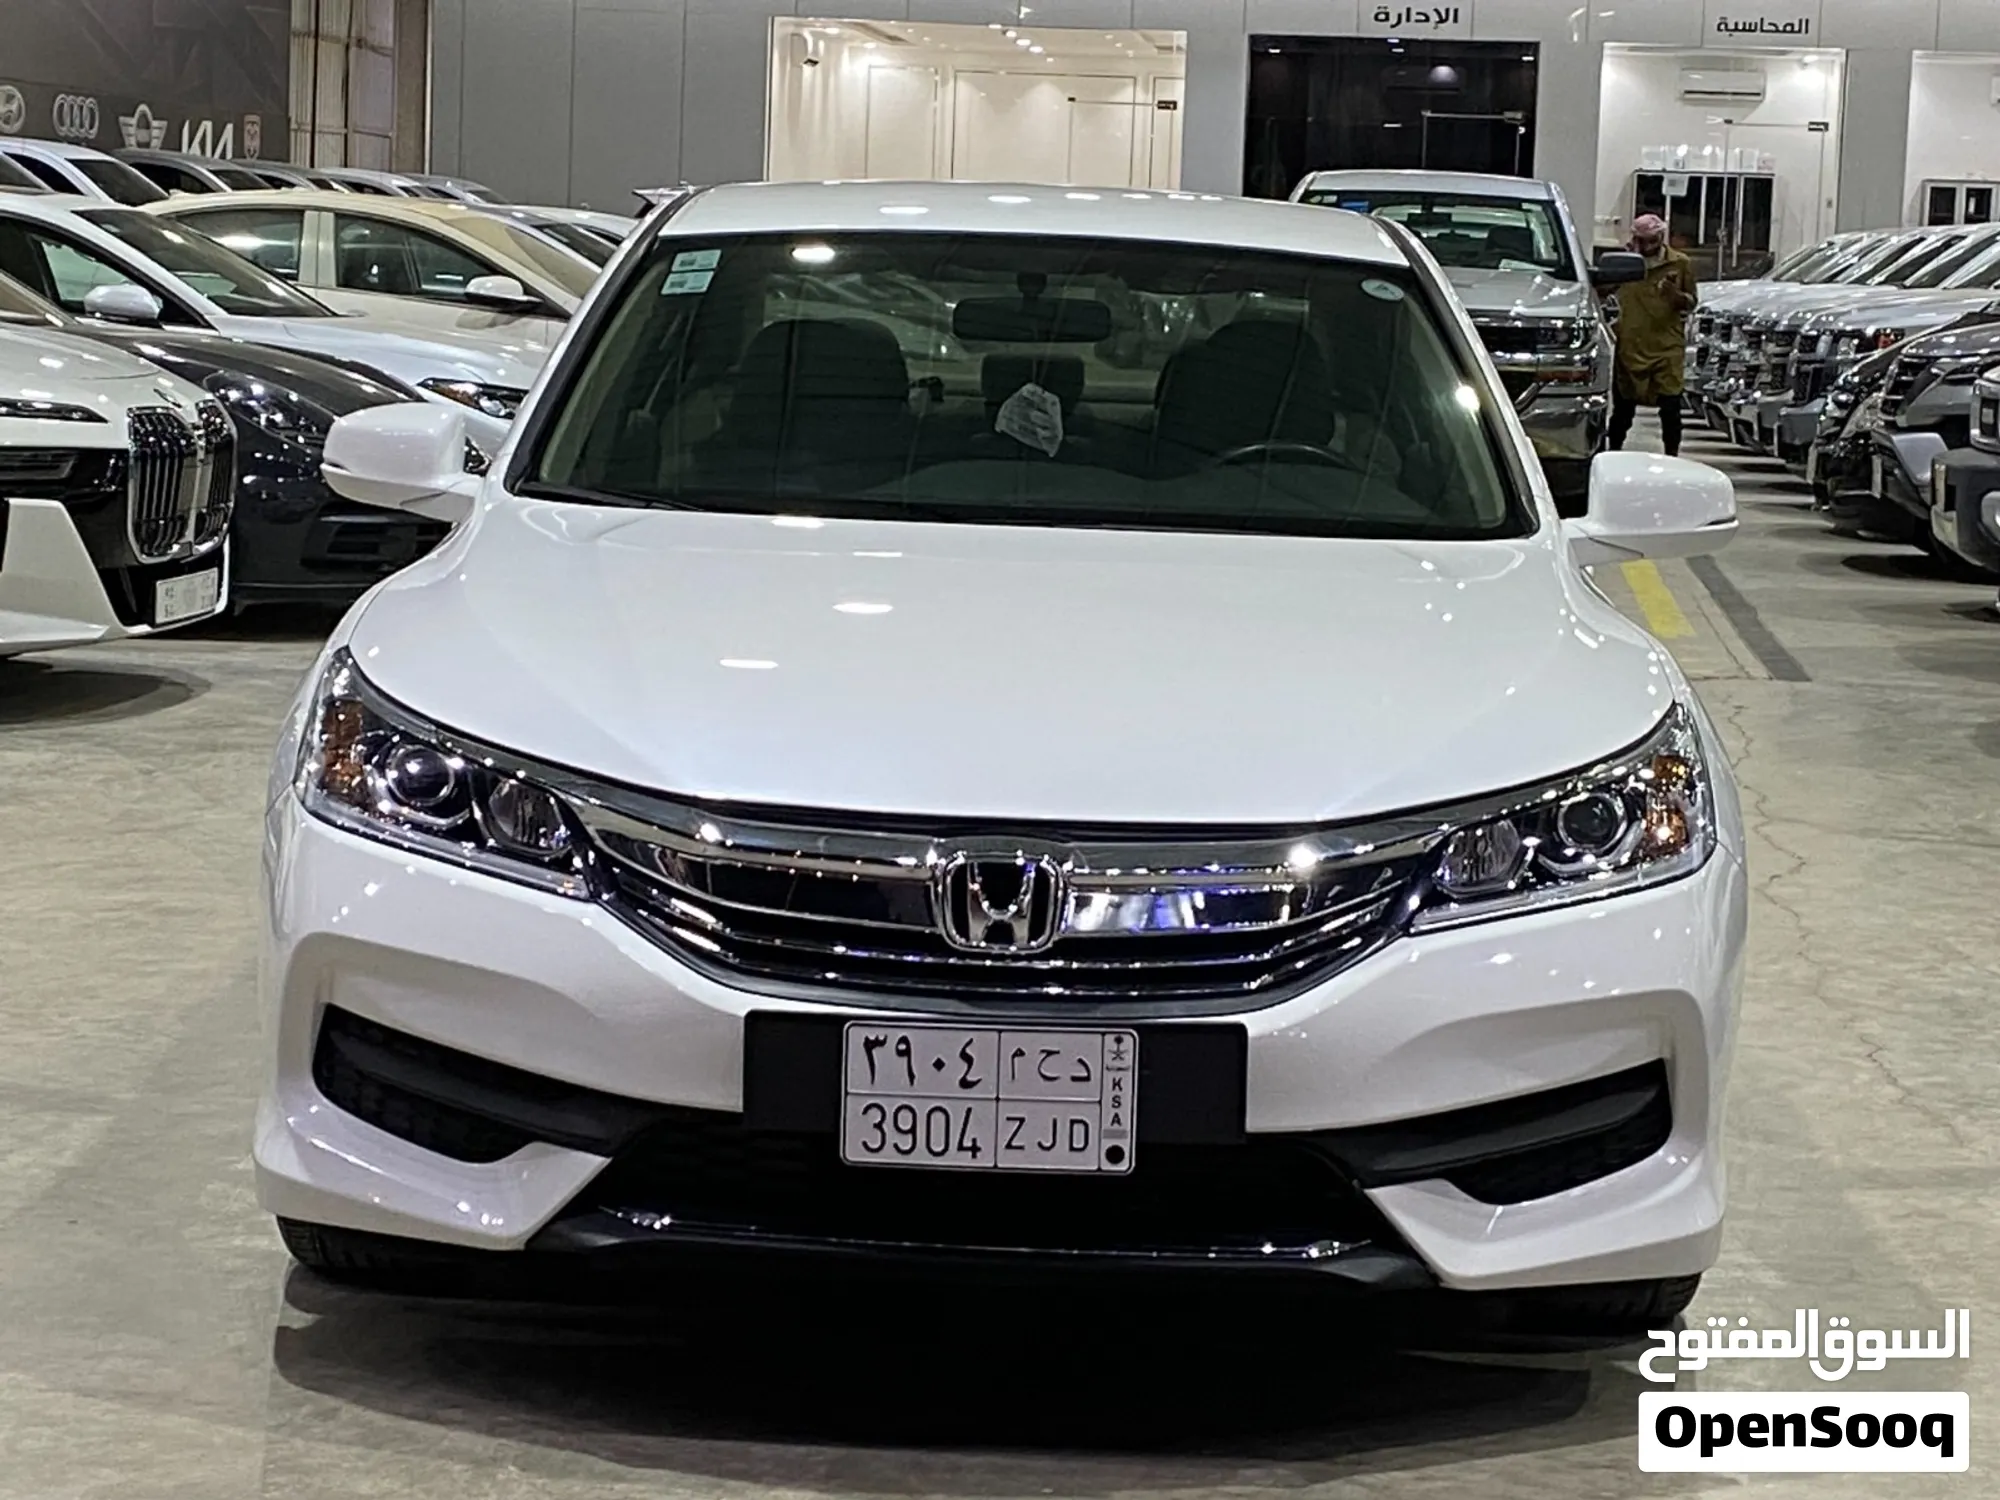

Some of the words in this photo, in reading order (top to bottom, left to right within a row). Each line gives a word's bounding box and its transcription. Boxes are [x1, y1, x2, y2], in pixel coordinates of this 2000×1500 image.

[1373, 6, 1459, 30] الإدارة
[1716, 16, 1810, 38] المحاسبة
[862, 1033, 983, 1090] ٣٩٠٤
[1109, 1076, 1124, 1127] KSA
[860, 1102, 983, 1160] 3904
